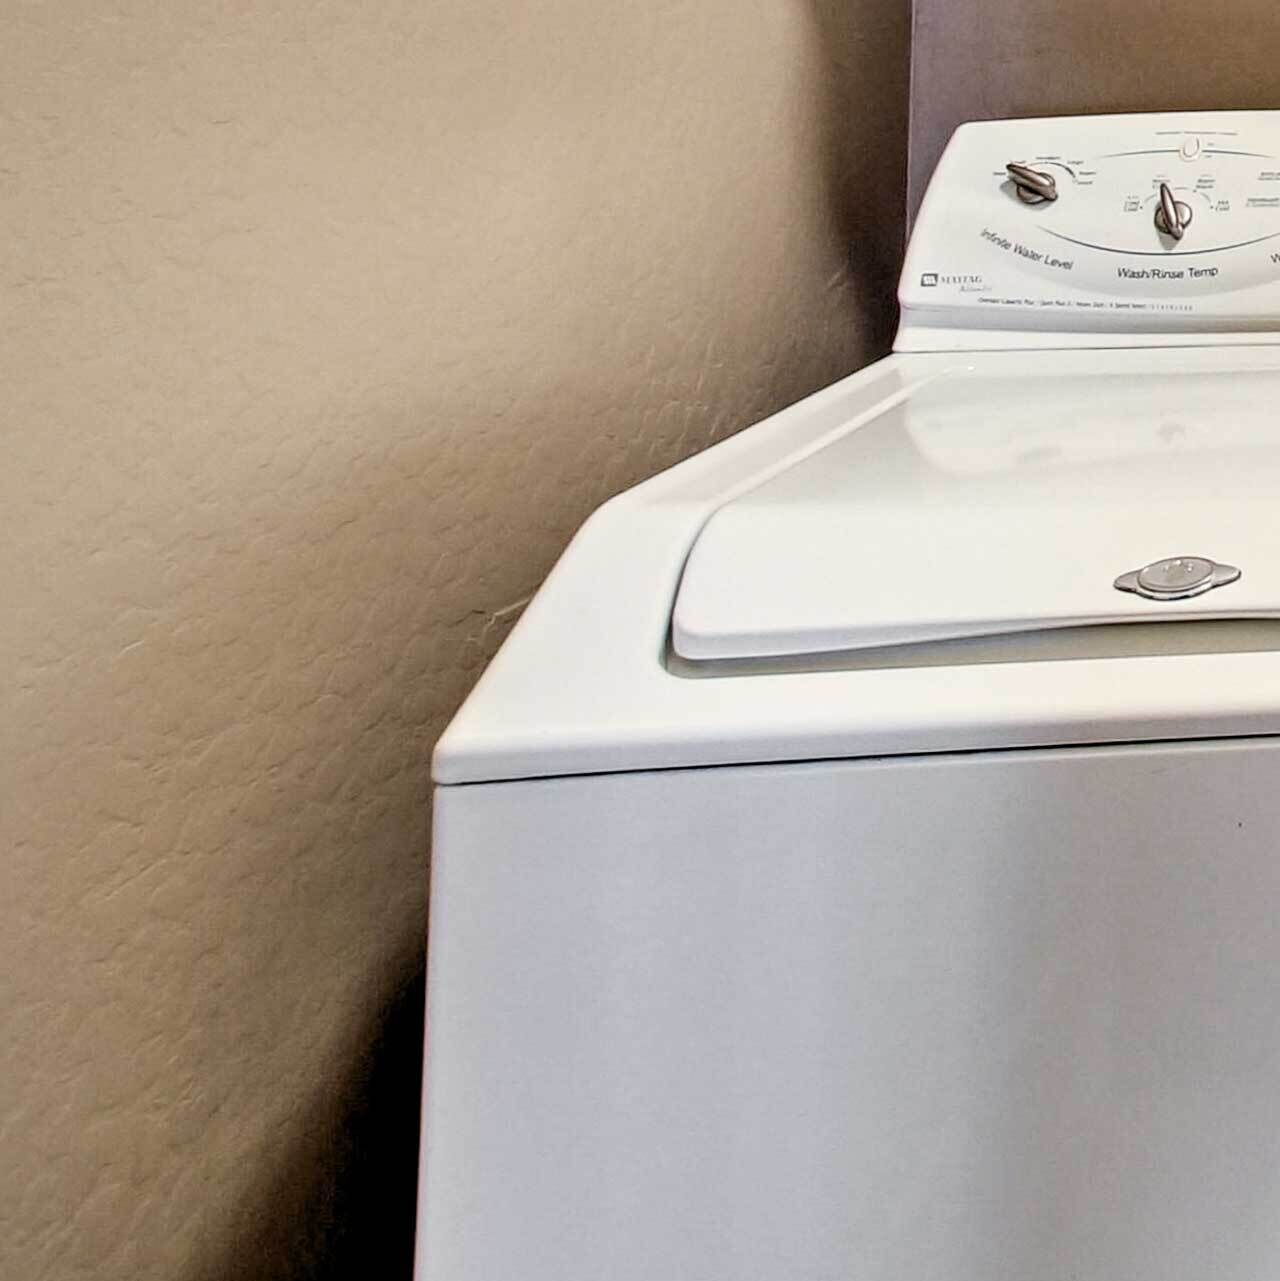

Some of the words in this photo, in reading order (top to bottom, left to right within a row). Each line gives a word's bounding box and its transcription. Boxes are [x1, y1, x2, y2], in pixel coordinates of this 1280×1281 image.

[980, 227, 1012, 251] Infinite
[1014, 242, 1043, 262] Water
[1044, 254, 1075, 271] Level
[1117, 268, 1184, 280] Wash/Rinse
[1187, 266, 1219, 280] Temp
